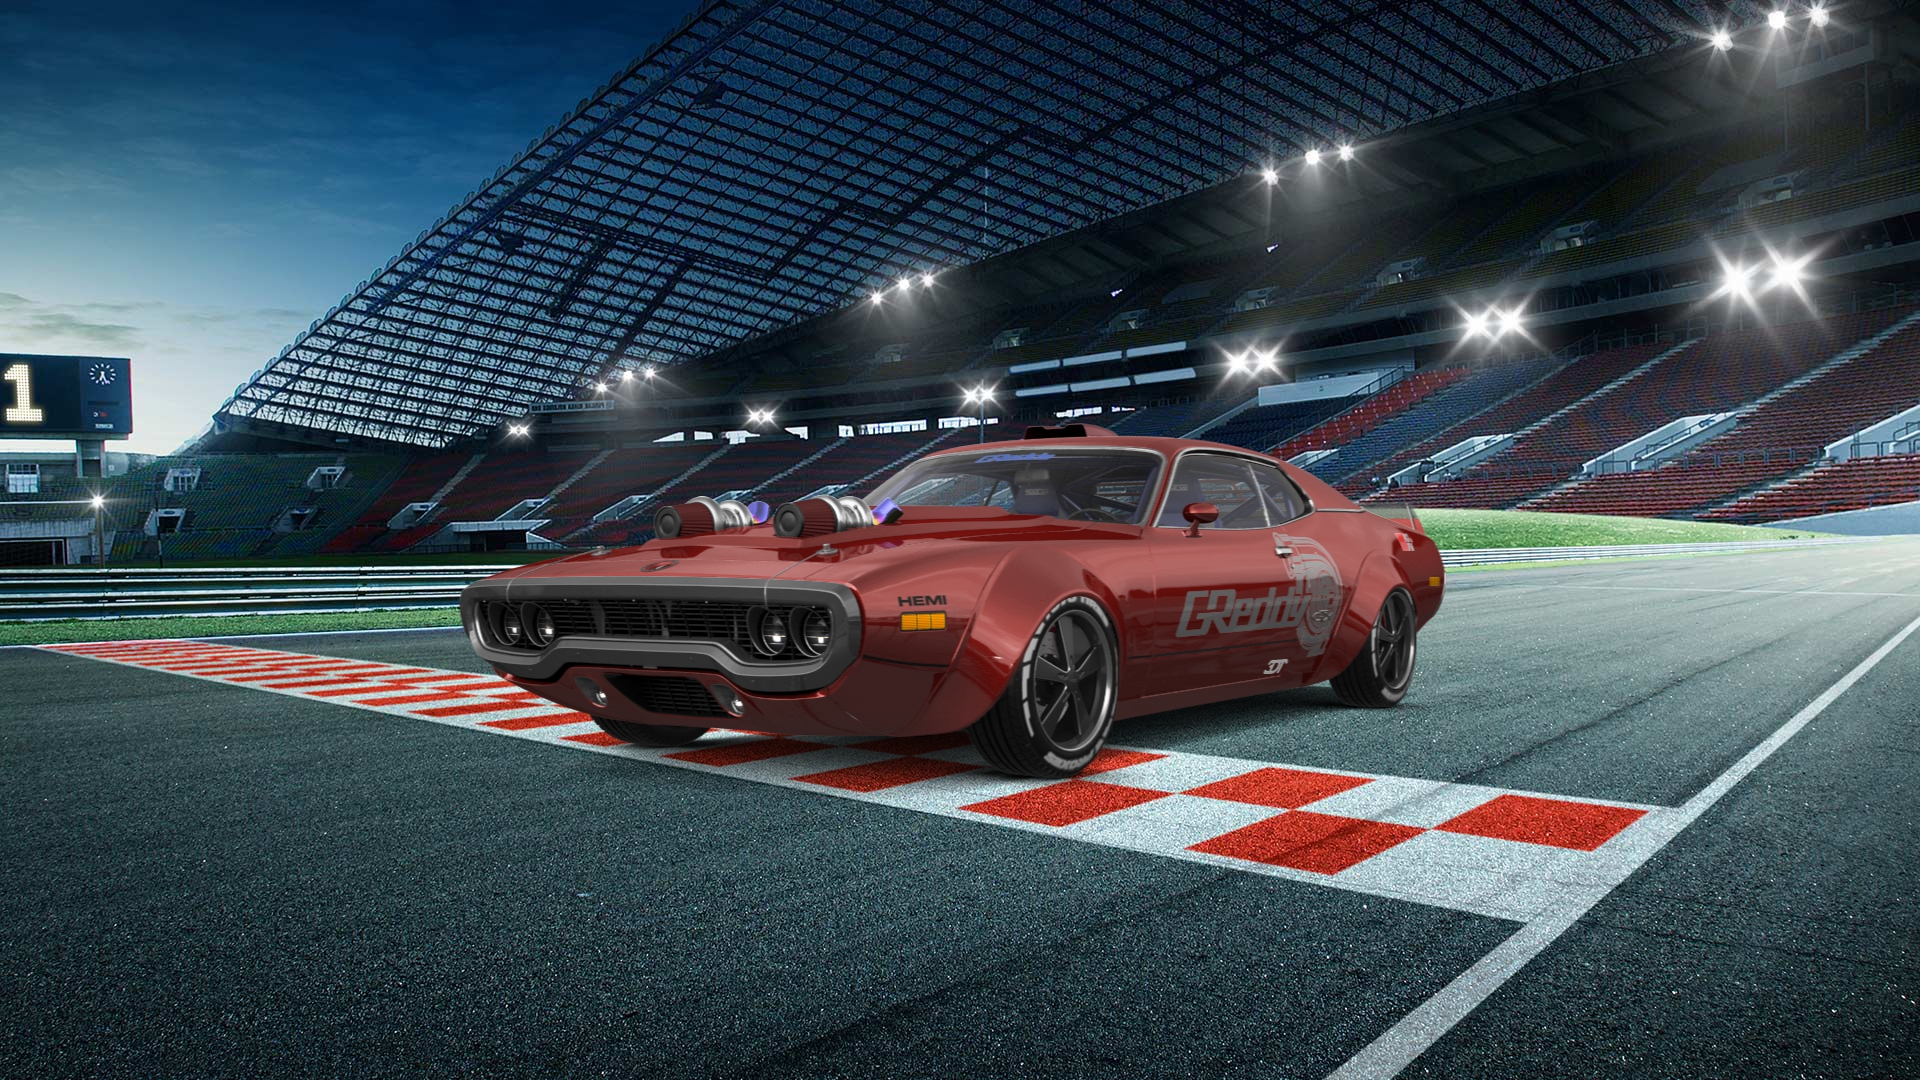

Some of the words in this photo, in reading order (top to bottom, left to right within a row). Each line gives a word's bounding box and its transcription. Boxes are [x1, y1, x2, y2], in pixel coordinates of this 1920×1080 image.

[4, 364, 43, 422] 1
[897, 595, 948, 607] HEMI
[1176, 587, 1311, 638] GReddy
